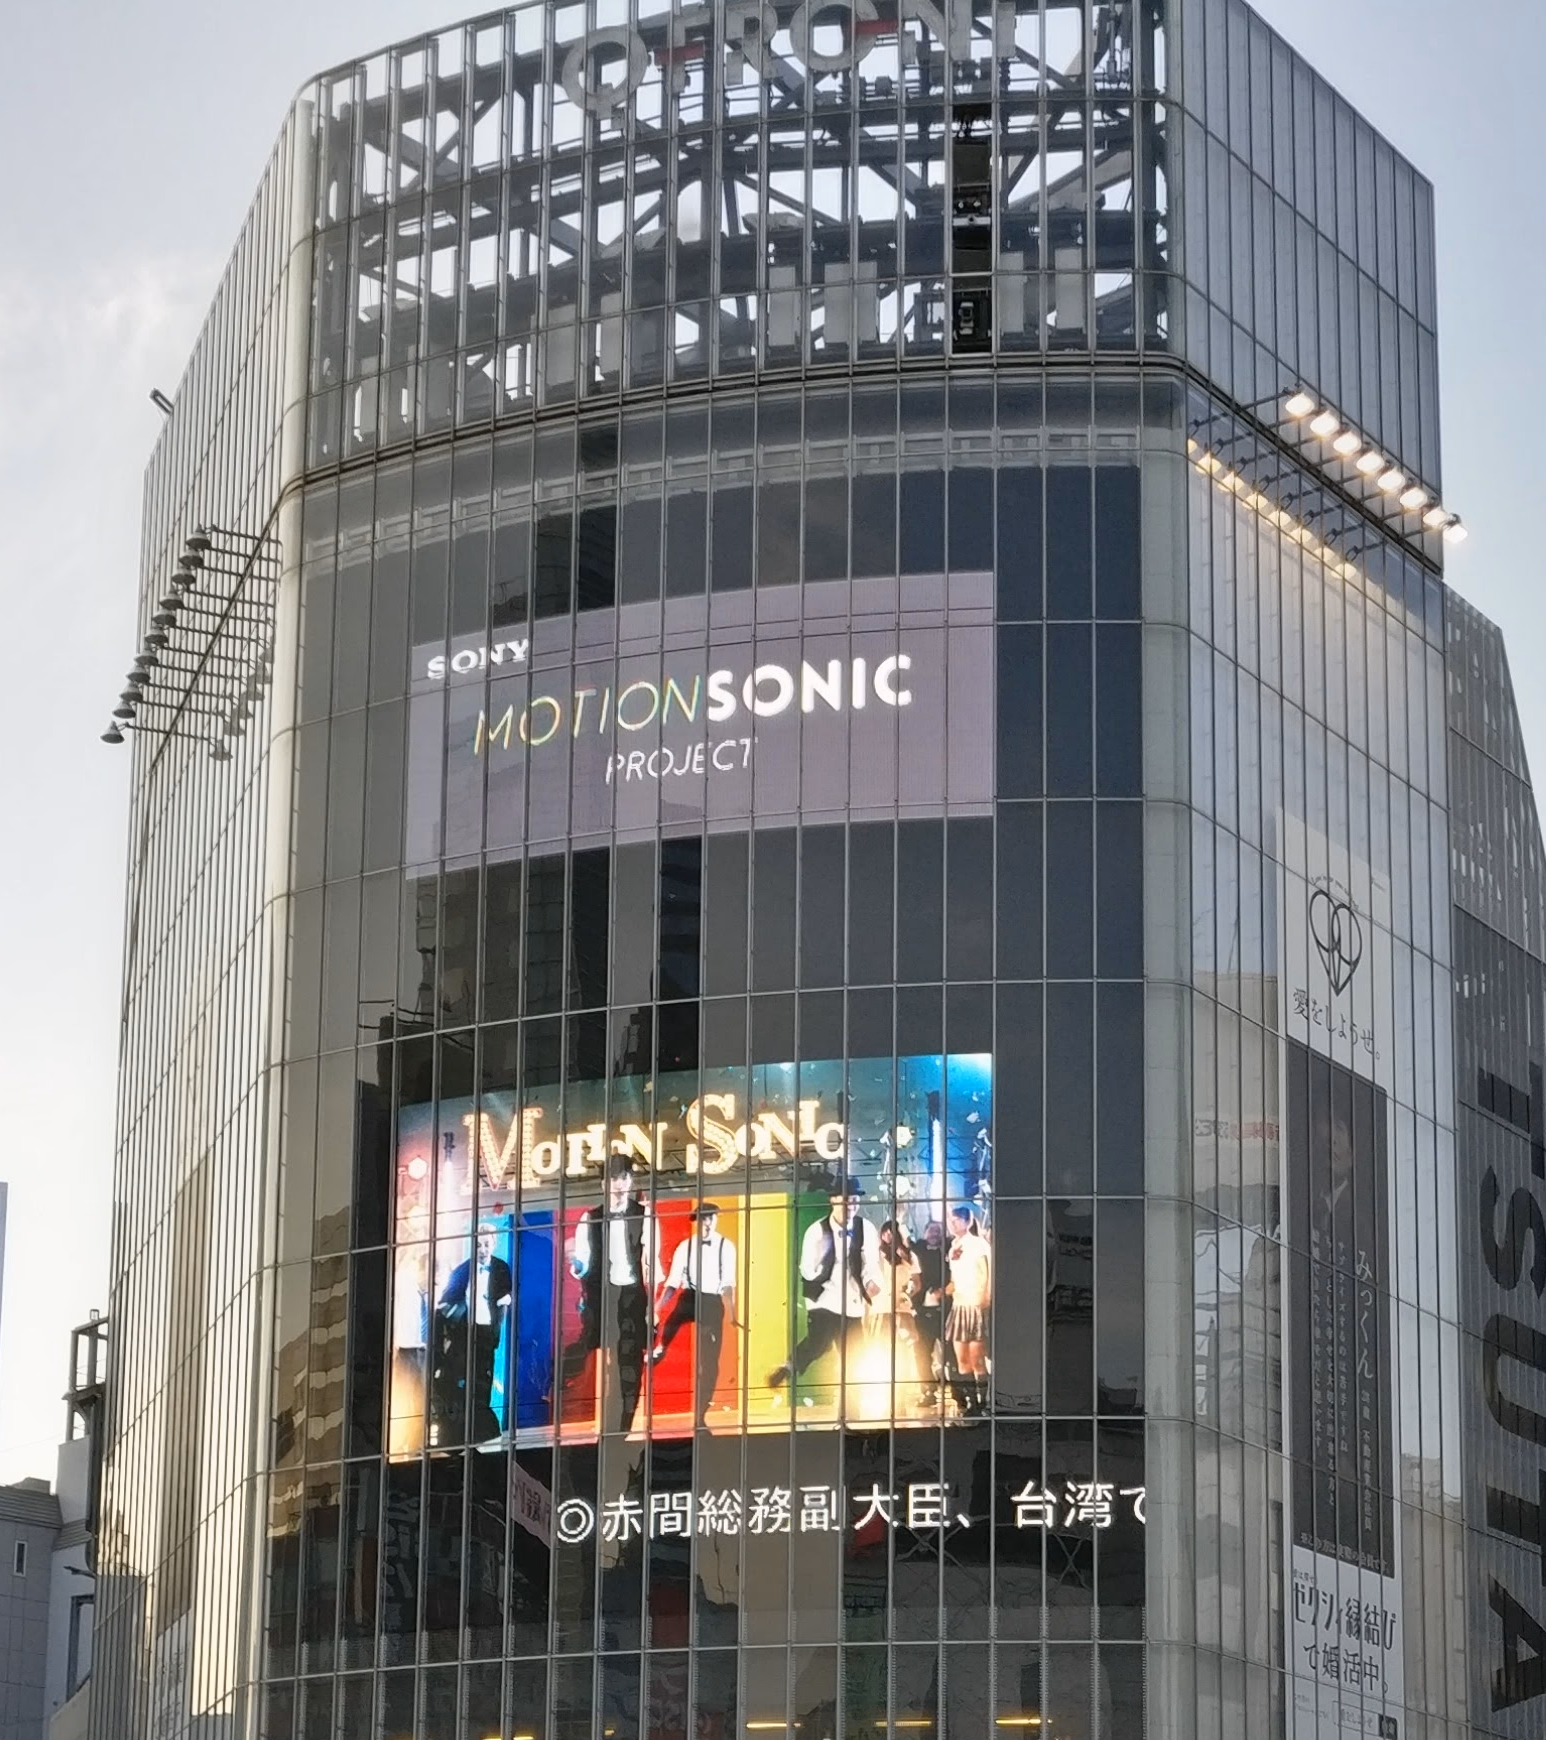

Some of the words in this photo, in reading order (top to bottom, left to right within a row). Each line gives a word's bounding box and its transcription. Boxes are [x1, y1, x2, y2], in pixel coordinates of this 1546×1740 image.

[427, 638, 529, 679] SONY
[605, 738, 756, 784] PROJECT
[685, 1093, 844, 1175] SONIC
[1356, 1250, 1373, 1379] みっくん
